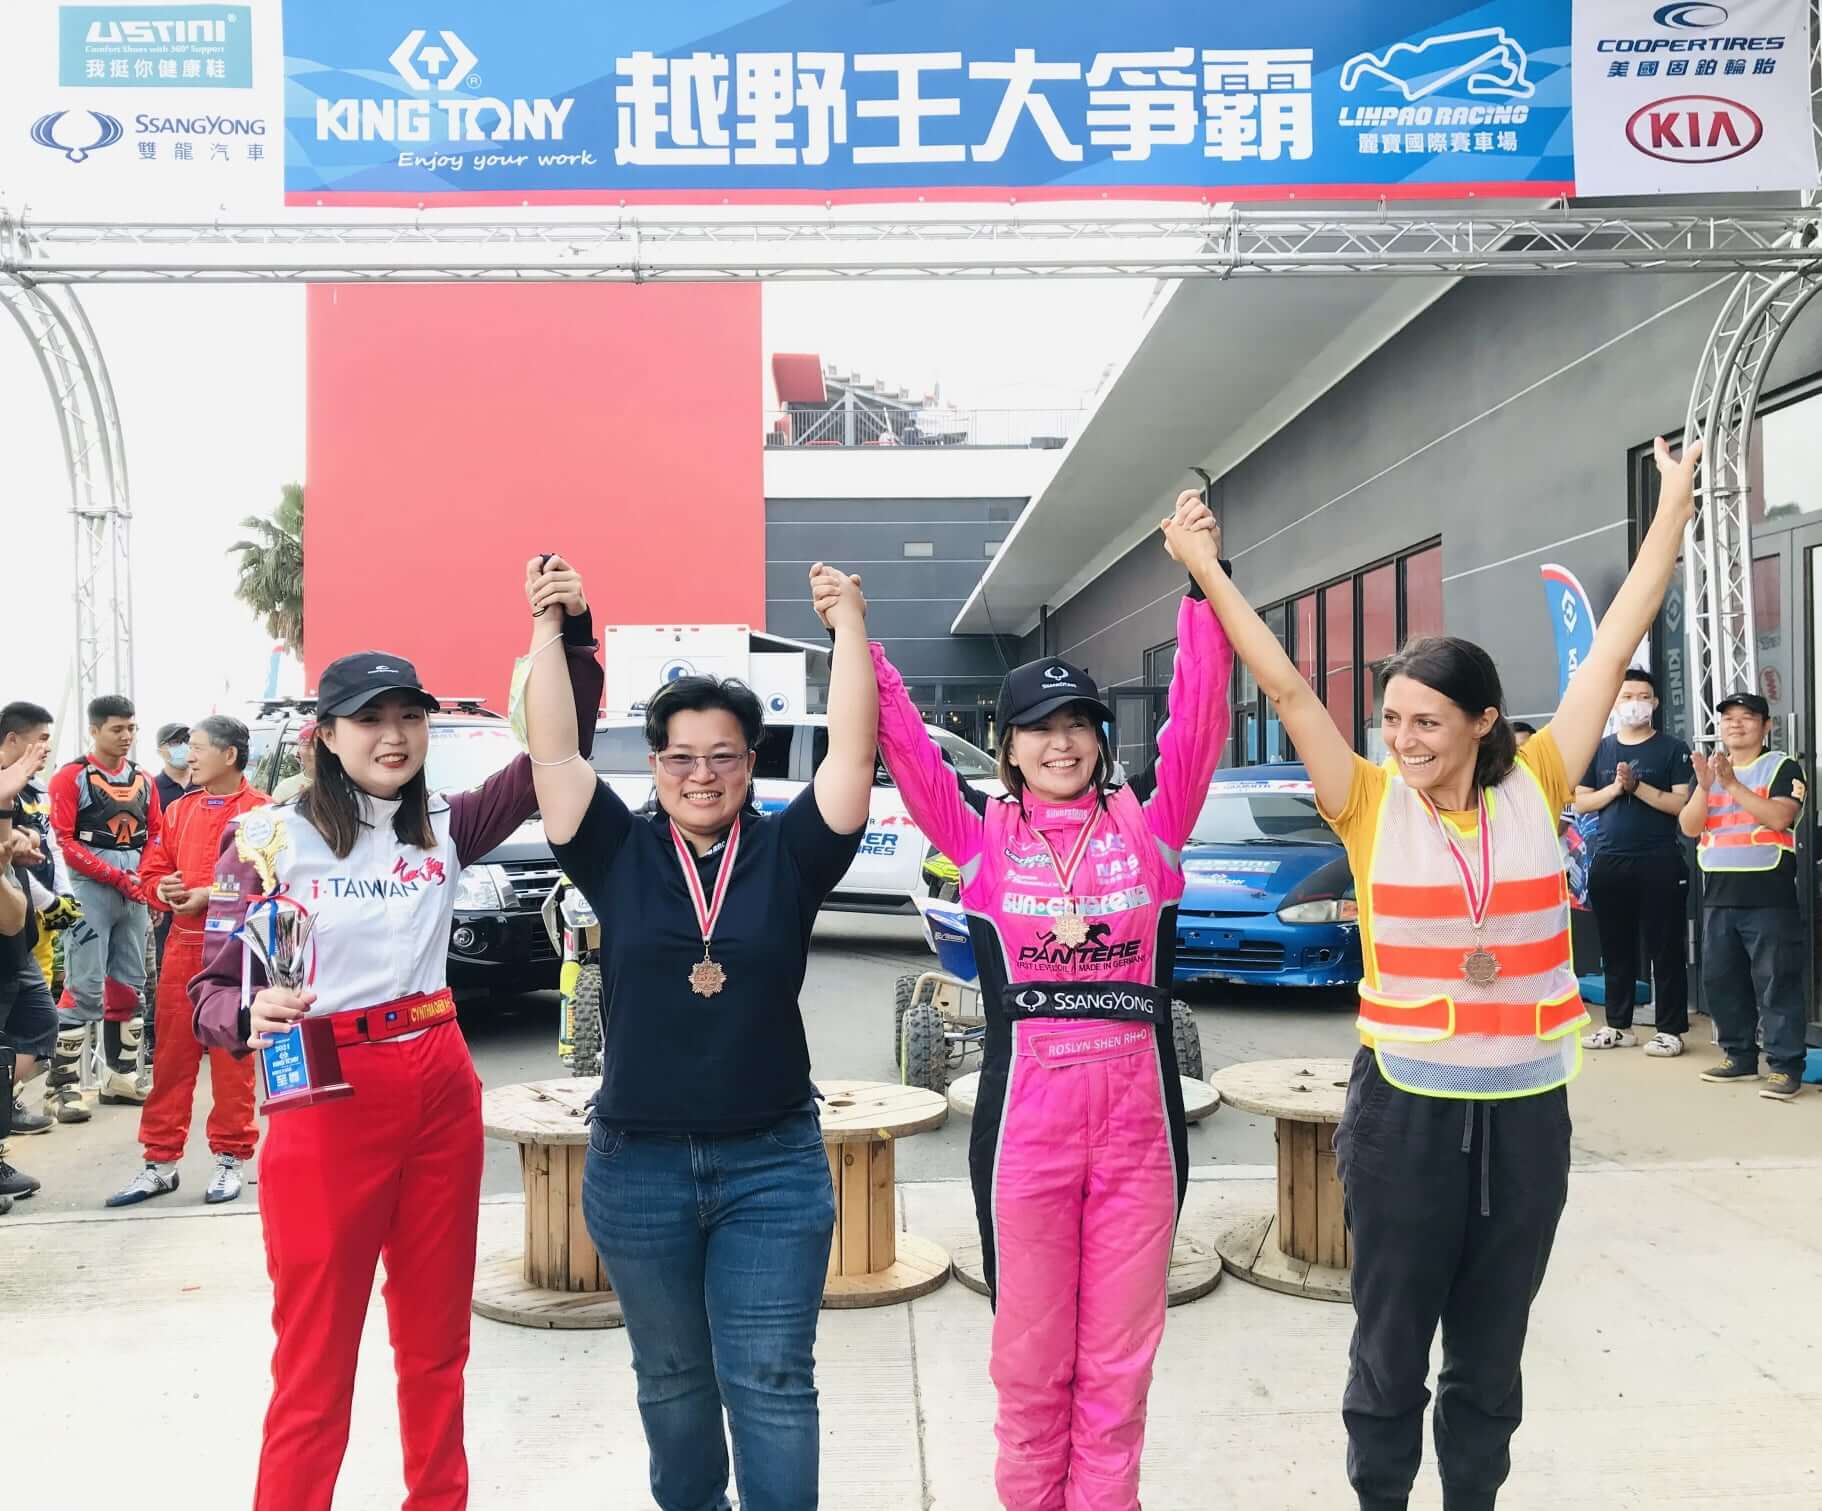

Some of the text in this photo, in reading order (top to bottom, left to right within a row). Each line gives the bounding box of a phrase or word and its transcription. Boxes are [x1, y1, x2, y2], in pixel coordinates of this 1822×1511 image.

[86, 20, 226, 43] USTINI
[85, 58, 226, 79] 我挺你健康鞋
[614, 47, 1314, 166] 越野王大爭霸
[1435, 104, 1530, 126] RACING
[316, 97, 575, 141] KING TONY
[1648, 111, 1742, 148] KIA
[137, 141, 265, 162] 雙龍汽車
[1358, 130, 1519, 154] 麗寶國際賽車場
[398, 150, 597, 172] Enjoy your work
[328, 878, 419, 898] TAIWAN
[1054, 992, 1154, 1014] SSANGYONG
[1048, 1043, 1091, 1057] ROSLYN
[1095, 1036, 1122, 1049] SHEN
